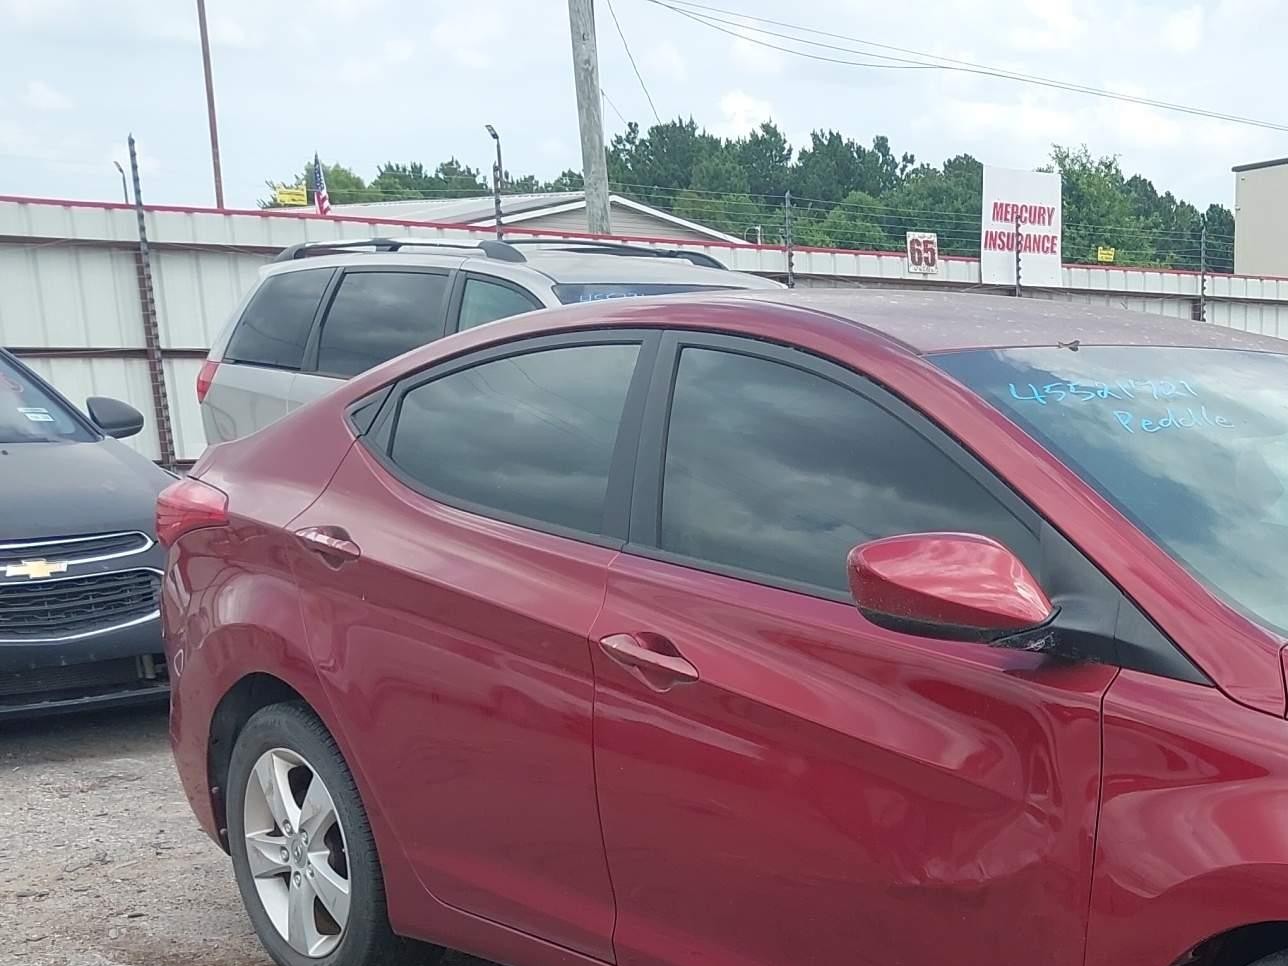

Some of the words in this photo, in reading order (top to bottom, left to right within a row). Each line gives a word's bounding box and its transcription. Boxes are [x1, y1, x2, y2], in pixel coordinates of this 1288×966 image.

[992, 202, 1055, 226] MERCURY
[910, 238, 936, 267] 65
[983, 230, 1058, 254] INSURANCE
